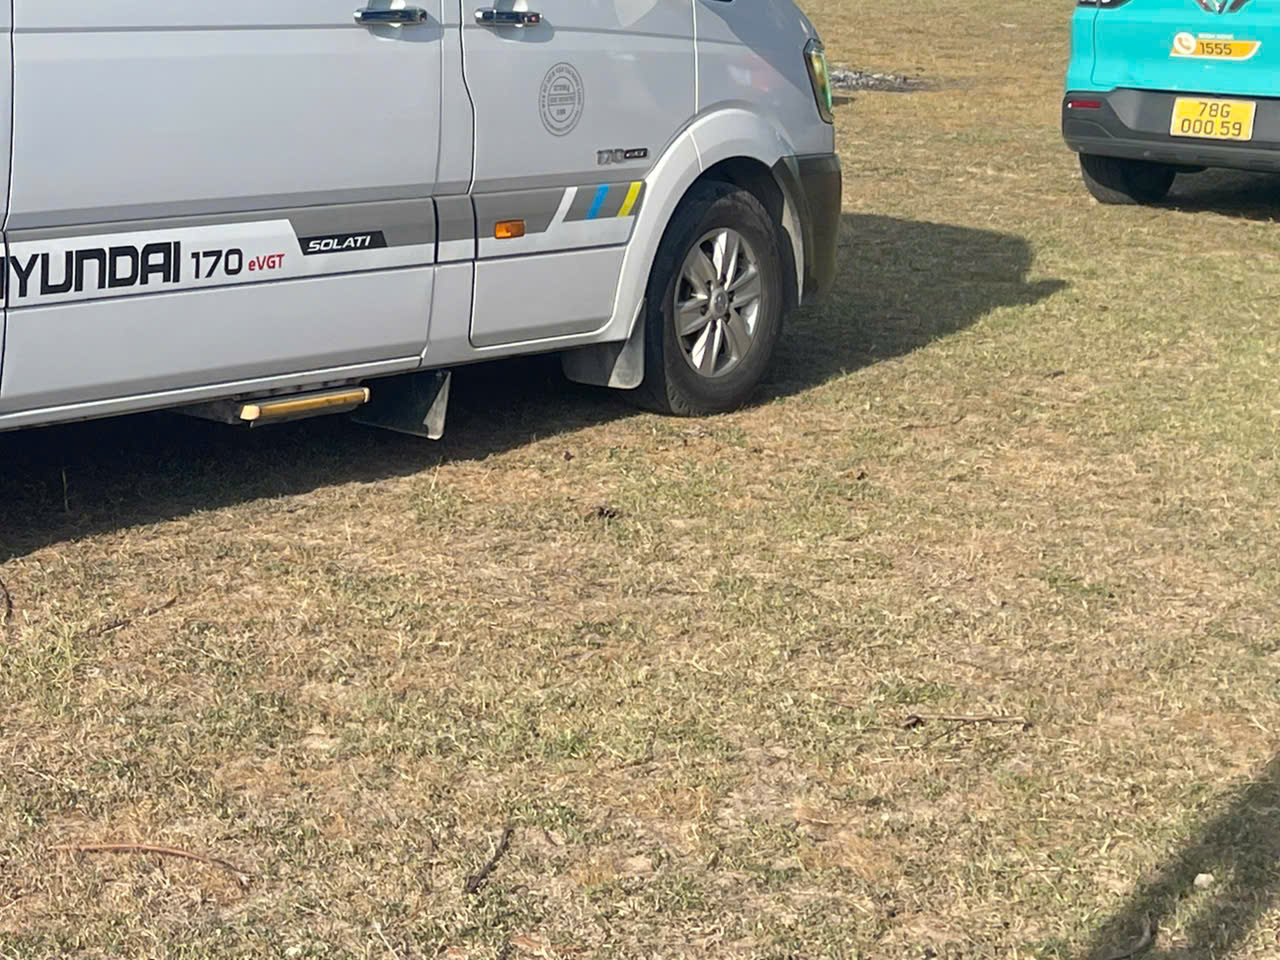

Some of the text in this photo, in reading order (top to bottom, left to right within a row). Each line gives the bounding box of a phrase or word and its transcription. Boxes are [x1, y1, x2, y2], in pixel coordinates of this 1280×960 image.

[1200, 42, 1232, 55] 1555
[1198, 102, 1231, 118] 78G
[1181, 118, 1242, 137] 000.59
[307, 235, 372, 253] SOLATI
[191, 249, 243, 279] 170
[247, 253, 286, 271] eVGT
